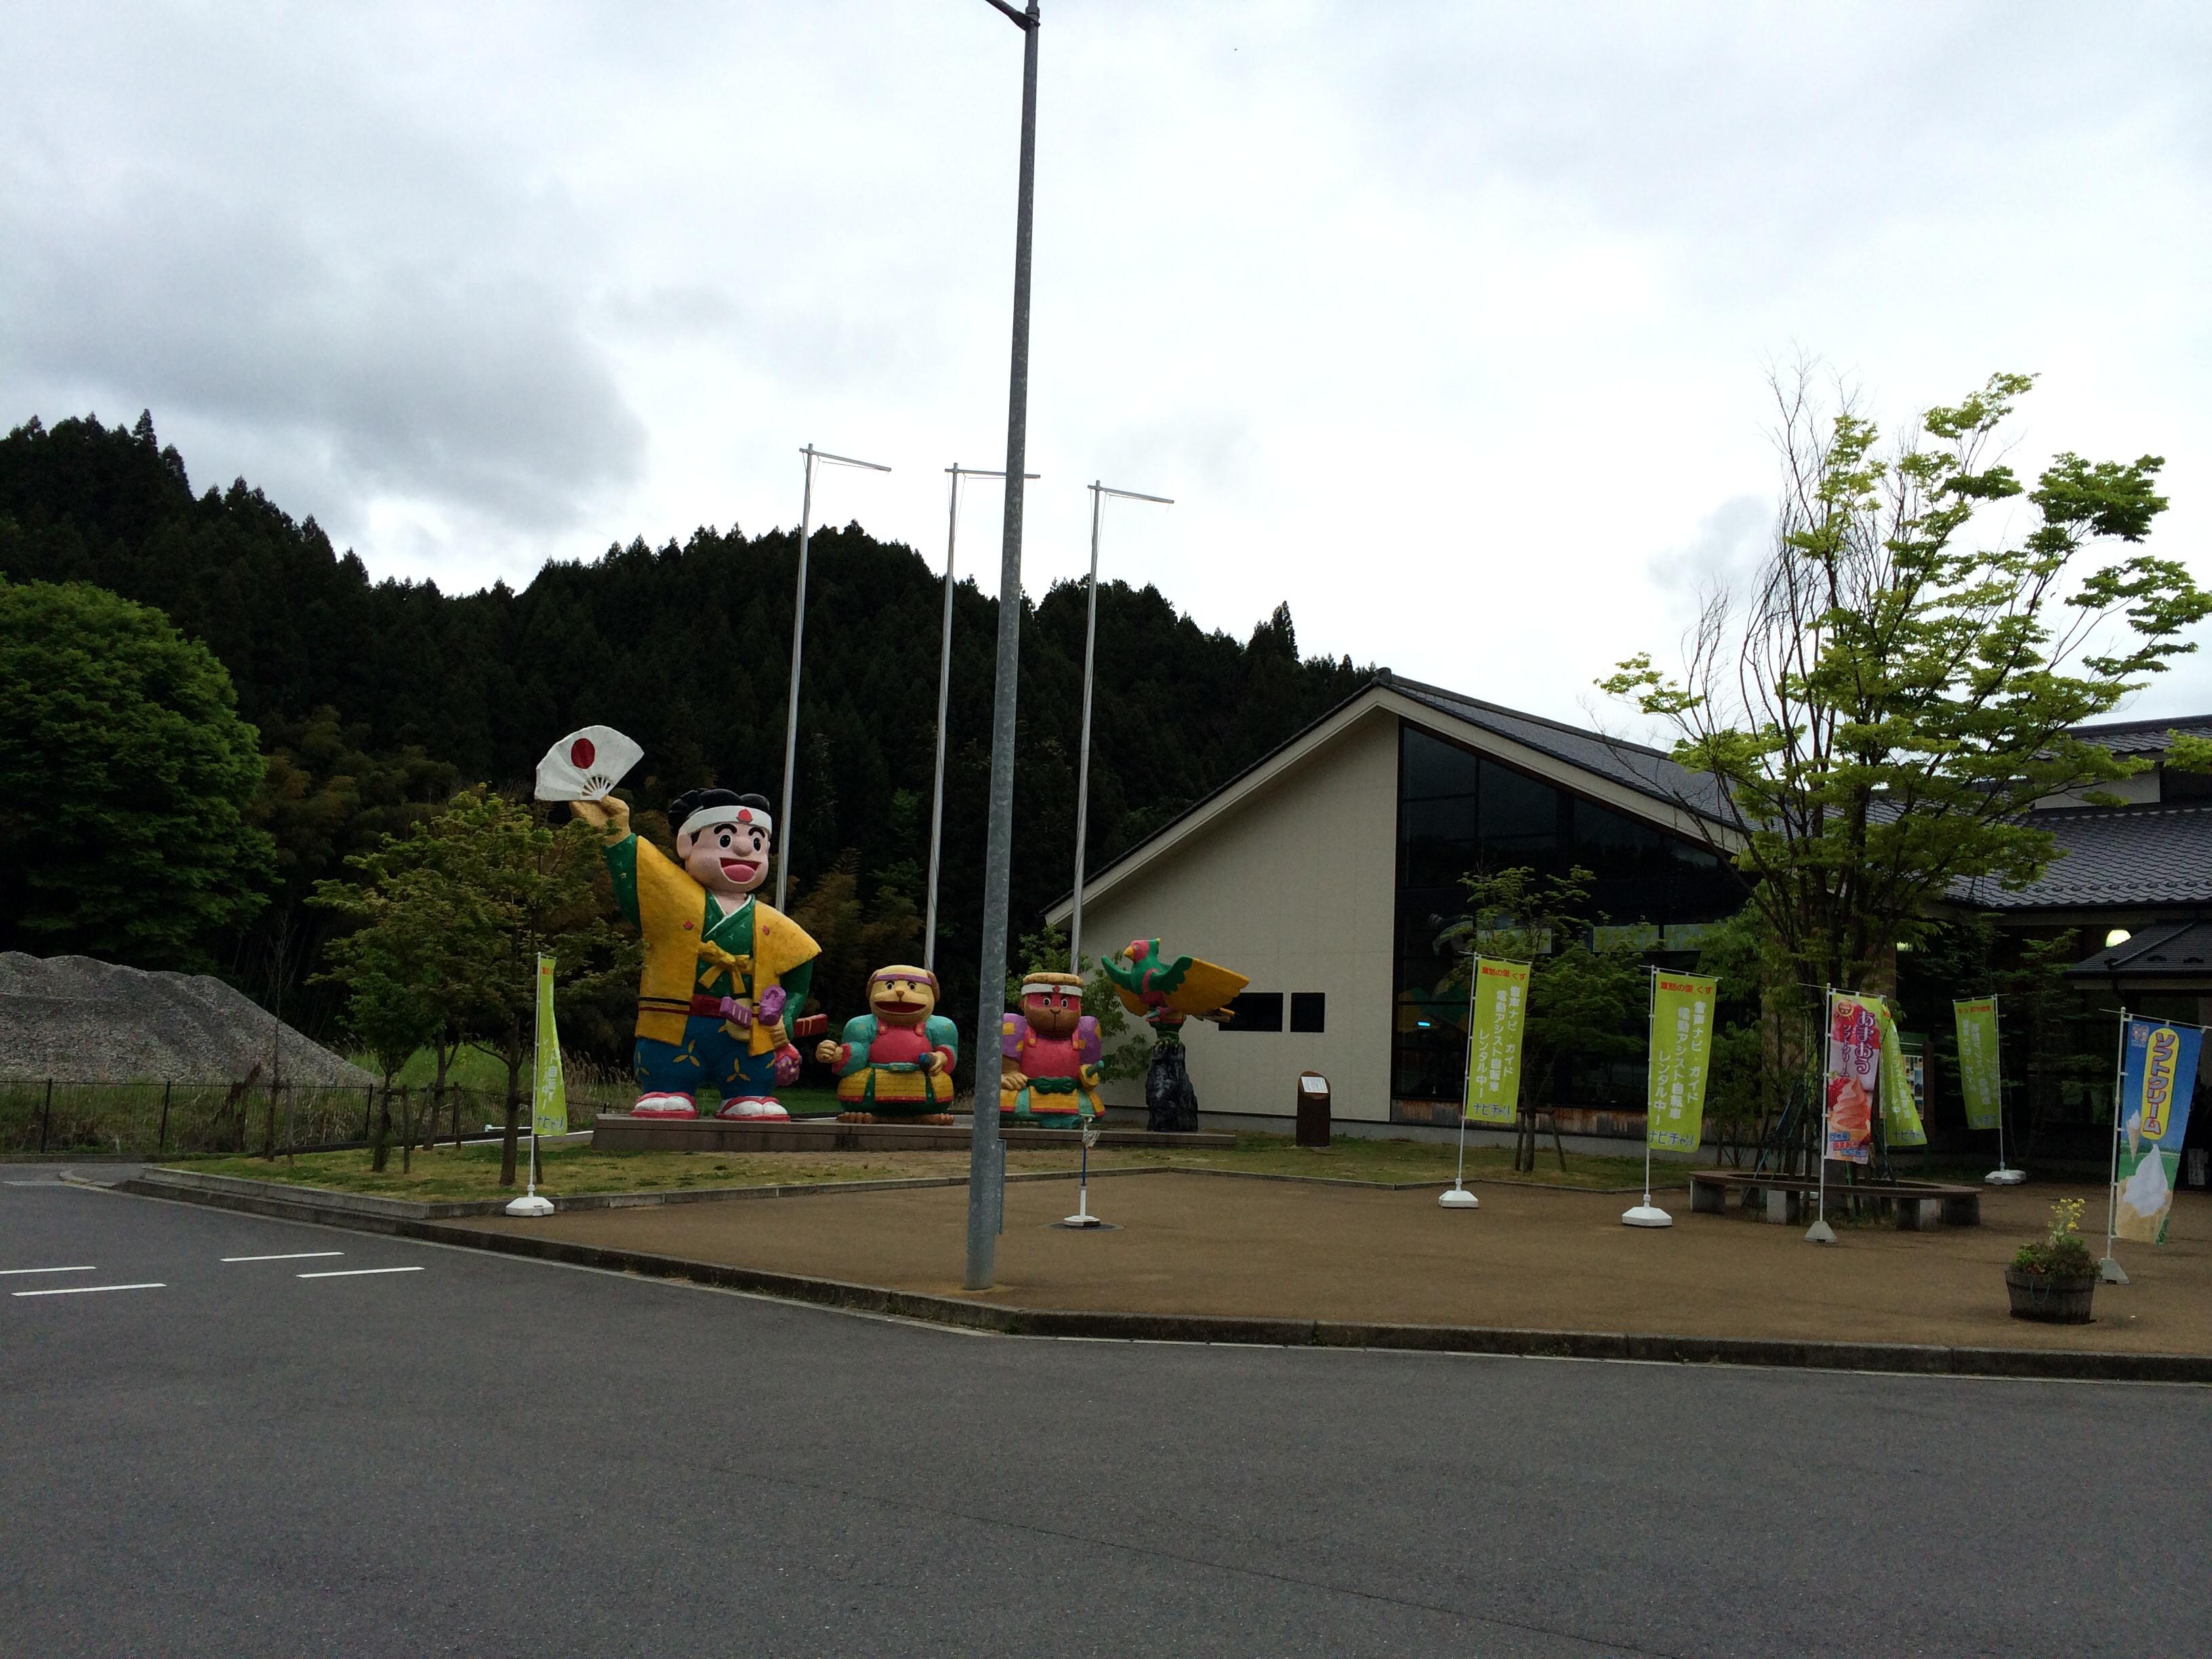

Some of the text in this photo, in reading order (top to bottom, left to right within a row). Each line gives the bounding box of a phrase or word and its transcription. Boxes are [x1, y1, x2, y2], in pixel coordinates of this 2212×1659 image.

[1839, 1024, 1853, 1078] ソフトクリーム
[1854, 1010, 1875, 1075] あまおう
[2143, 1031, 2175, 1135] ソフトクリーム
